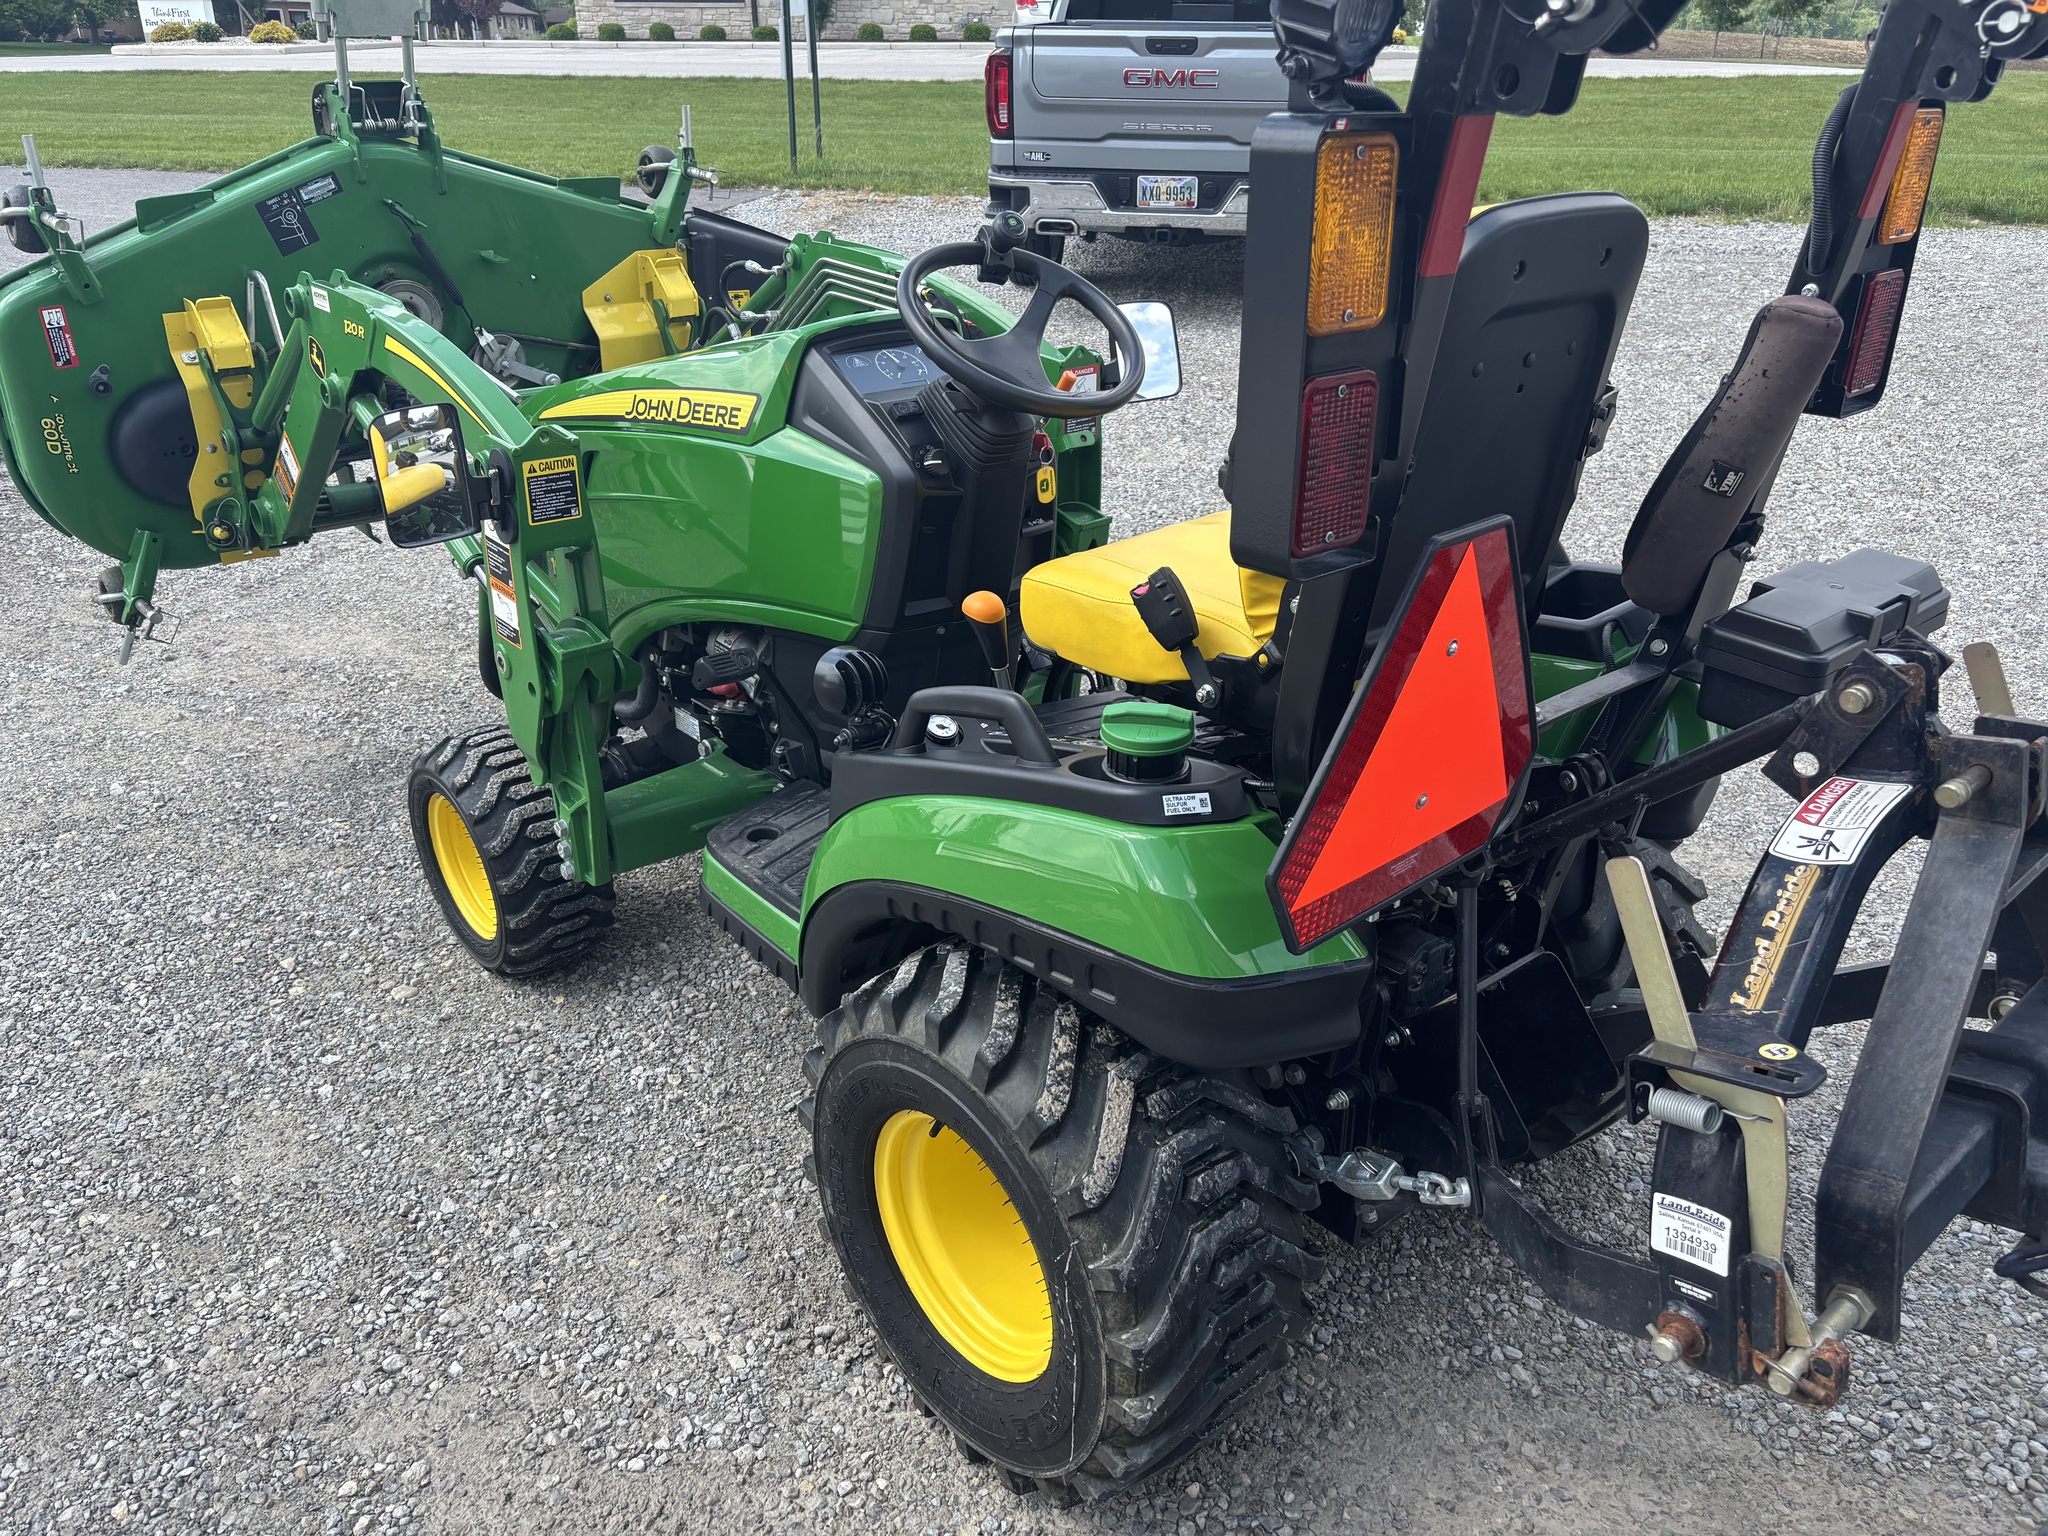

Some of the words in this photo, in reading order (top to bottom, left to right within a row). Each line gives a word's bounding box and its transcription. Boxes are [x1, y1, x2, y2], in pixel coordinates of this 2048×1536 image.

[1123, 68, 1218, 88] GMC
[1122, 122, 1213, 132] SIERRA
[1166, 186, 1192, 202] 9953
[1075, 368, 1094, 376] DANGER
[626, 394, 673, 418] JOHN
[676, 397, 742, 426] DEERE
[41, 418, 62, 455] 60D
[538, 458, 574, 472] CAUTION
[1719, 472, 1736, 491] VDP
[1808, 780, 1853, 812] DANGER
[1730, 936, 1777, 1012] Land
[1762, 865, 1811, 933] Pride
[1657, 1197, 1691, 1213] Land
[1695, 1208, 1726, 1229] Pride
[1678, 1216, 1696, 1226] Kansas
[1682, 1224, 1696, 1232] Serial
[1665, 1226, 1717, 1254] 1394939
